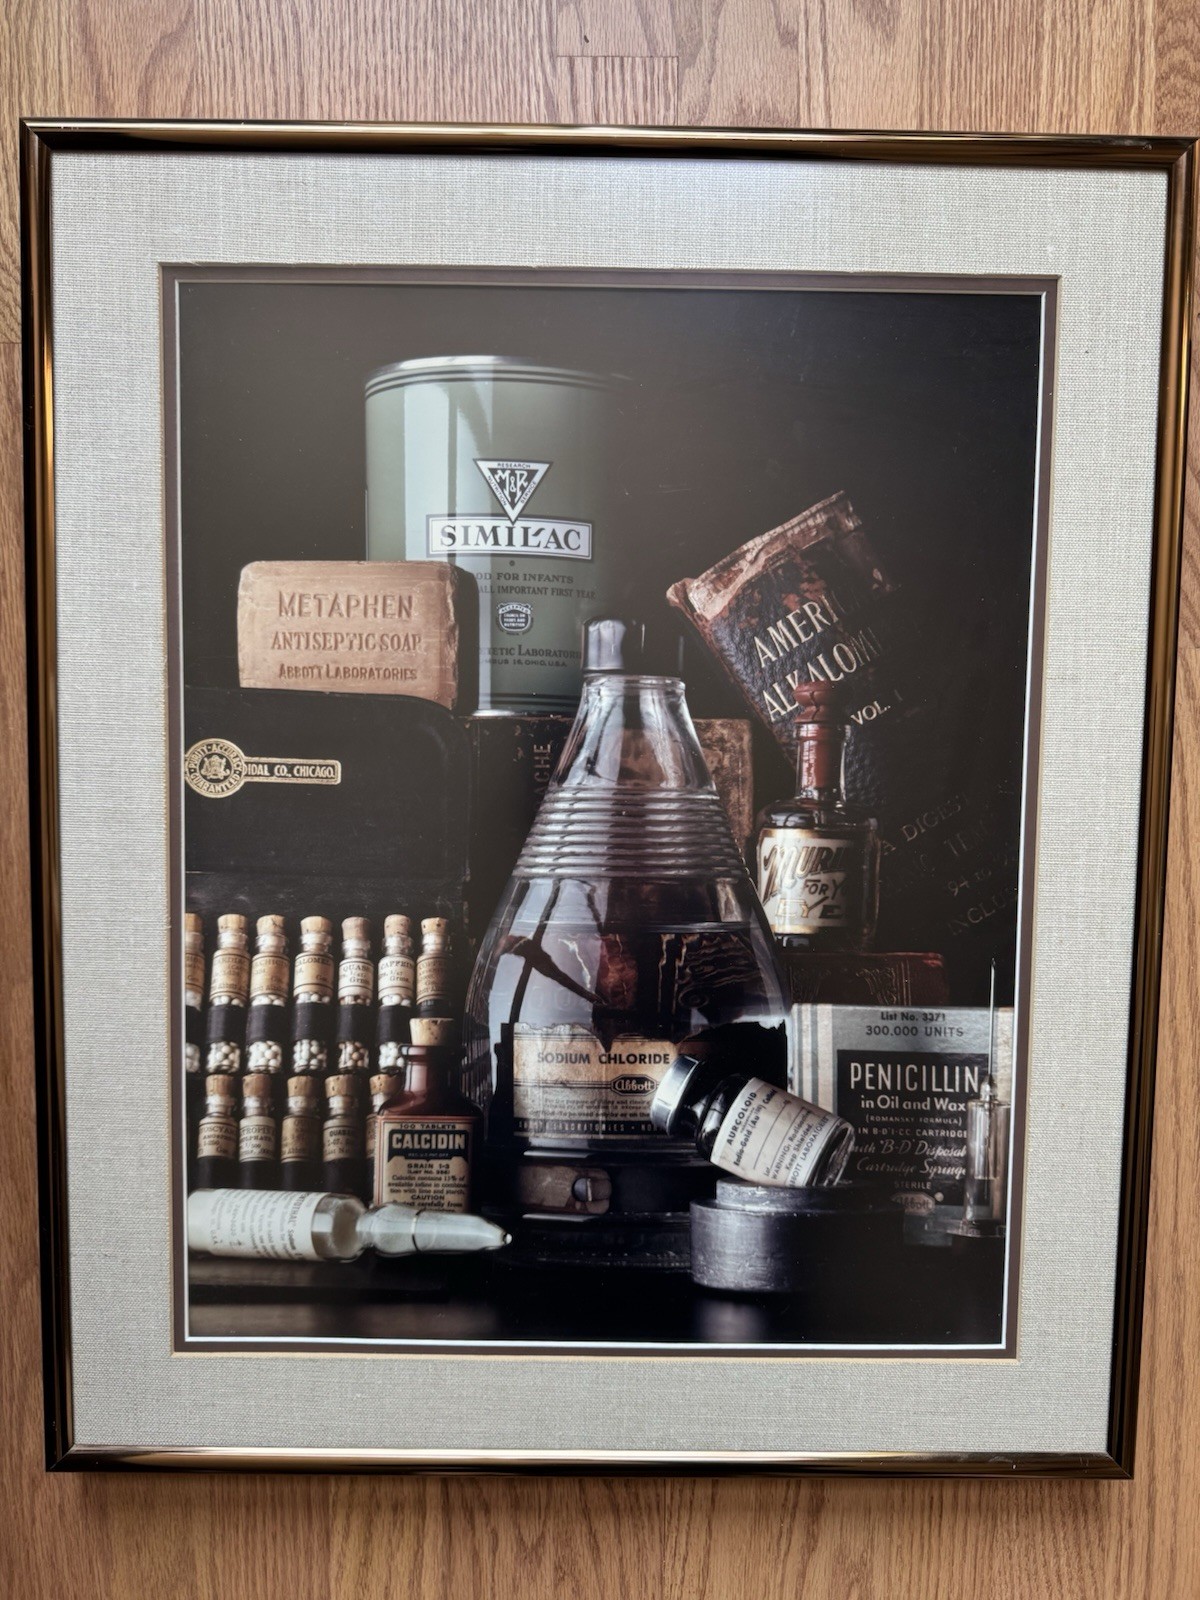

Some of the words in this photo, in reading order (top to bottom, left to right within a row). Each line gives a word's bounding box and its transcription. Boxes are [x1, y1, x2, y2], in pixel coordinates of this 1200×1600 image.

[520, 481, 537, 504] SERVICE
[496, 572, 519, 581] FOR
[523, 573, 574, 584] INFANTS
[497, 586, 549, 596] IMPORTANT
[550, 588, 574, 598] FIRST
[278, 591, 414, 619] METAPHEN
[271, 631, 378, 650] ANTISEPTIC
[278, 663, 324, 679] ABBOTT
[325, 664, 418, 681] LABORATORIES
[851, 700, 891, 726] VOL.
[188, 744, 209, 769] PURITY
[211, 743, 242, 772] ACCURACY
[190, 774, 241, 793] GUARANTEED
[804, 879, 829, 895] FOR
[880, 1011, 898, 1021] List
[901, 1012, 919, 1021] No.
[924, 1026, 965, 1038] UNITS
[537, 1052, 591, 1065] SODIUM
[598, 1052, 671, 1065] CHLORIDE
[850, 1062, 980, 1093] PENICILLIN
[860, 1094, 875, 1109] in
[876, 1095, 900, 1110] Oil
[902, 1096, 931, 1111] and
[933, 1096, 967, 1113] Wax
[726, 1091, 757, 1146] AURCOLOID
[391, 1132, 466, 1150] CALCIDIN
[785, 1152, 798, 1172] Keep
[856, 1156, 915, 1178] Cartridge
[894, 1180, 932, 1190] STERILE
